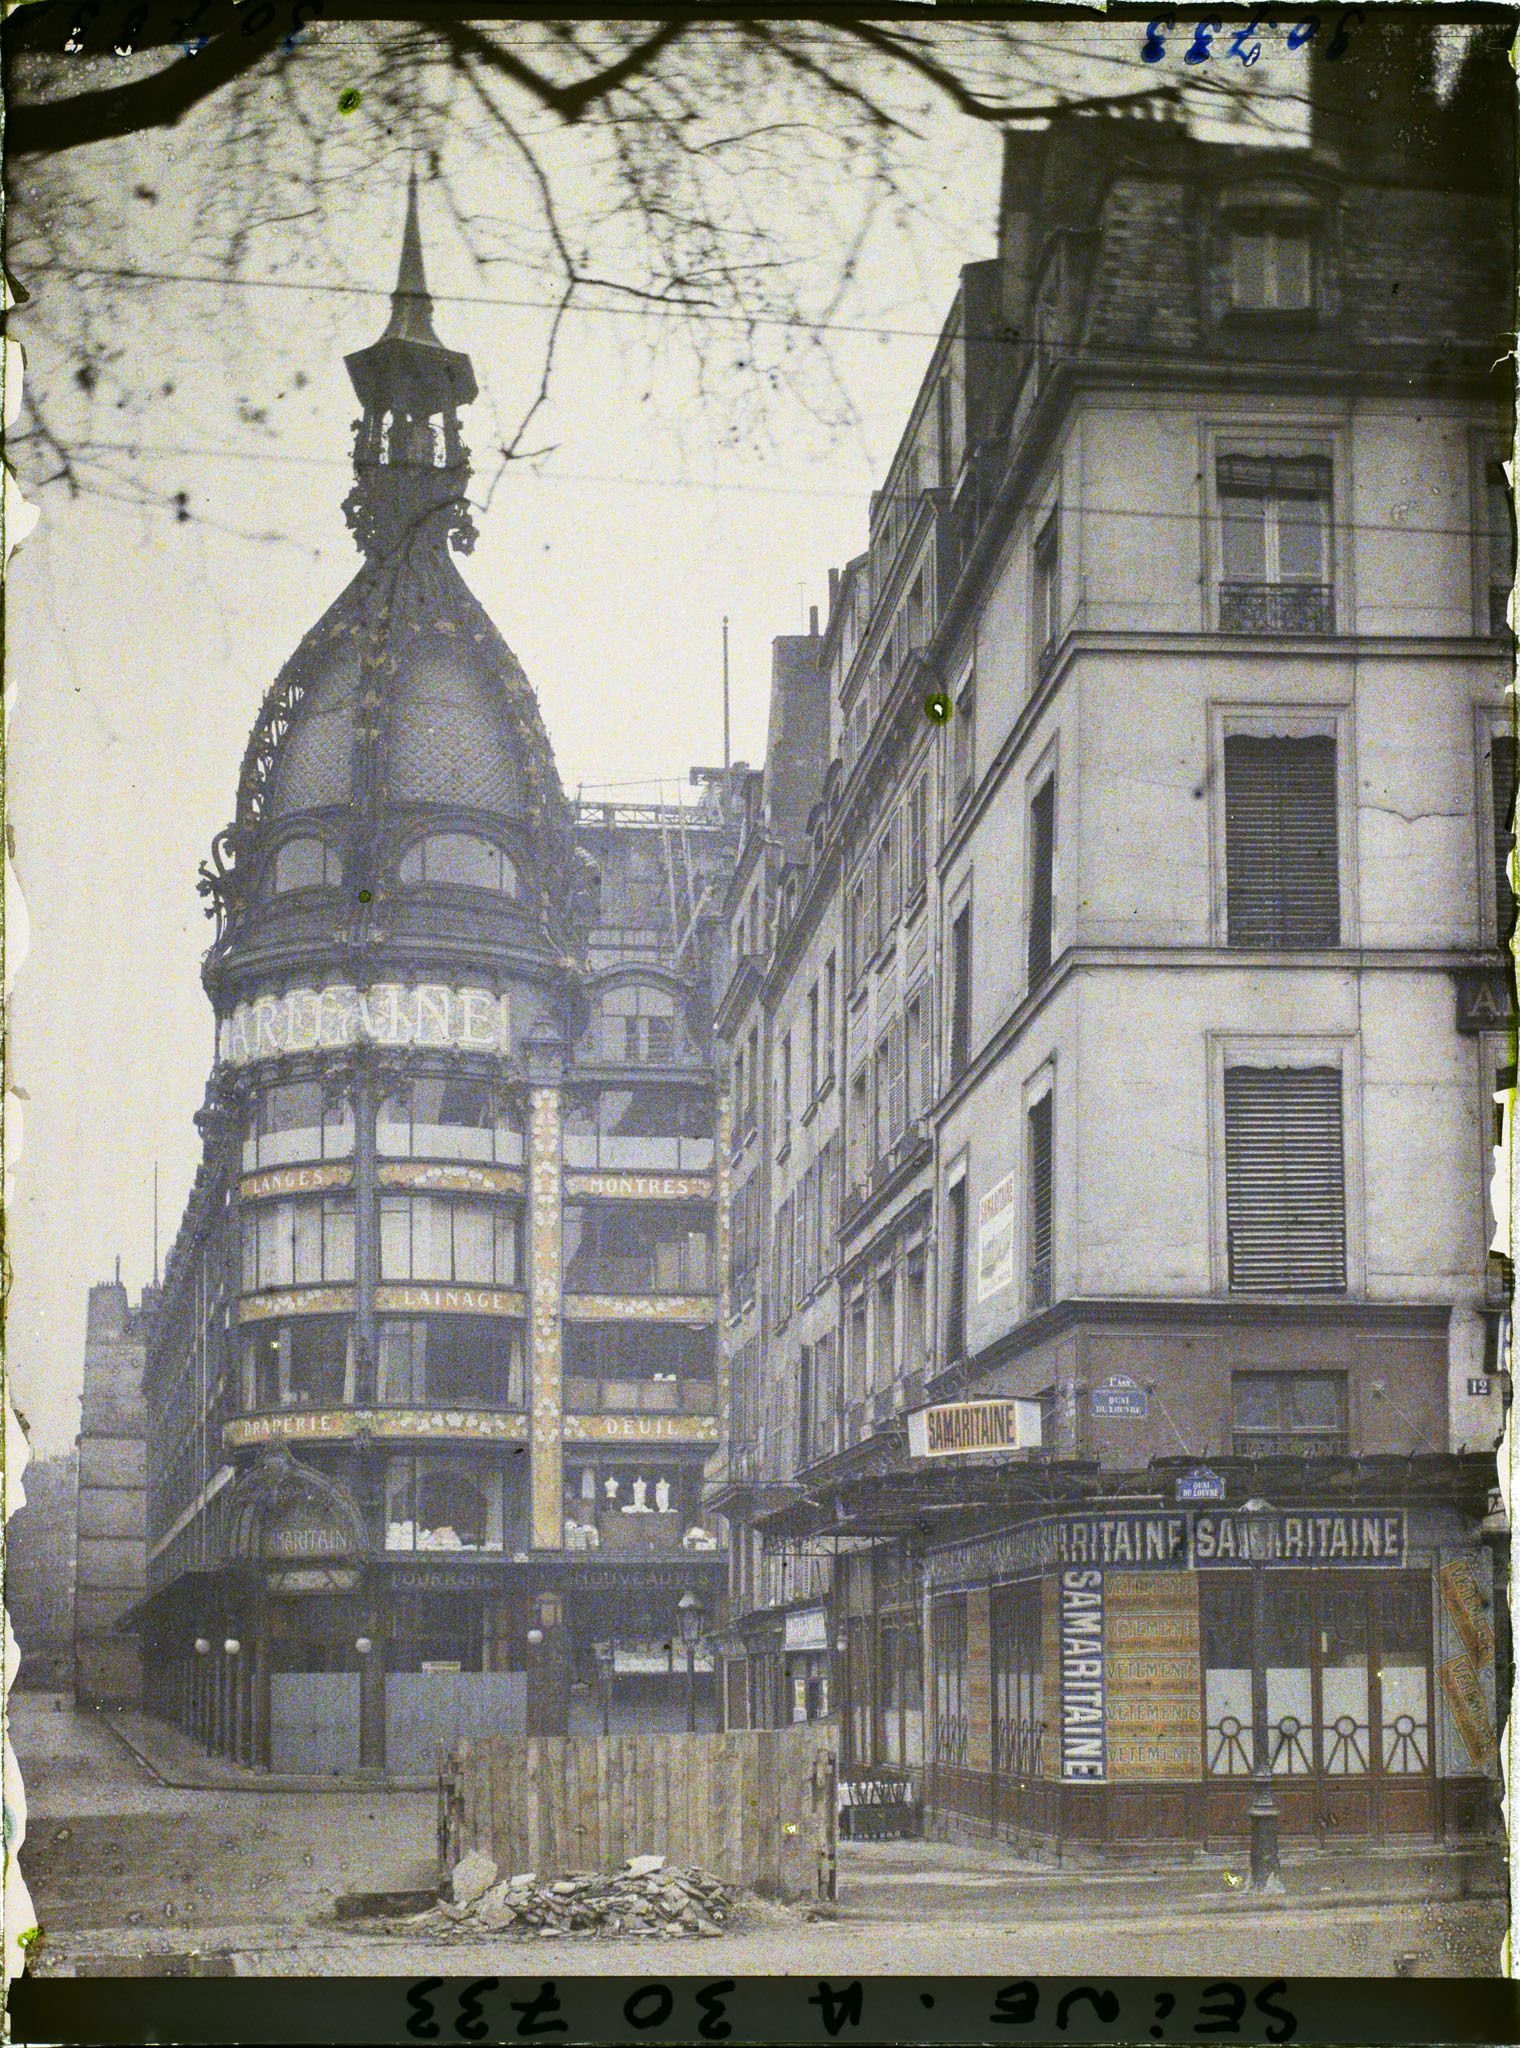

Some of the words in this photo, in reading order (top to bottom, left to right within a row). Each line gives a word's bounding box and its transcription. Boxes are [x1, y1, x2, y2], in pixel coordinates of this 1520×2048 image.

[589, 1177, 689, 1196] MONTRES
[404, 1289, 503, 1310] LAINAGE
[1472, 1380, 1488, 1394] 12
[244, 1415, 331, 1437] DRAPERIE
[606, 1418, 681, 1436] DEUIL
[928, 1404, 1015, 1450] SAMARITAINE
[1042, 1519, 1182, 1564] ARITAINE
[1063, 1570, 1103, 1776] SAMARITAINE
